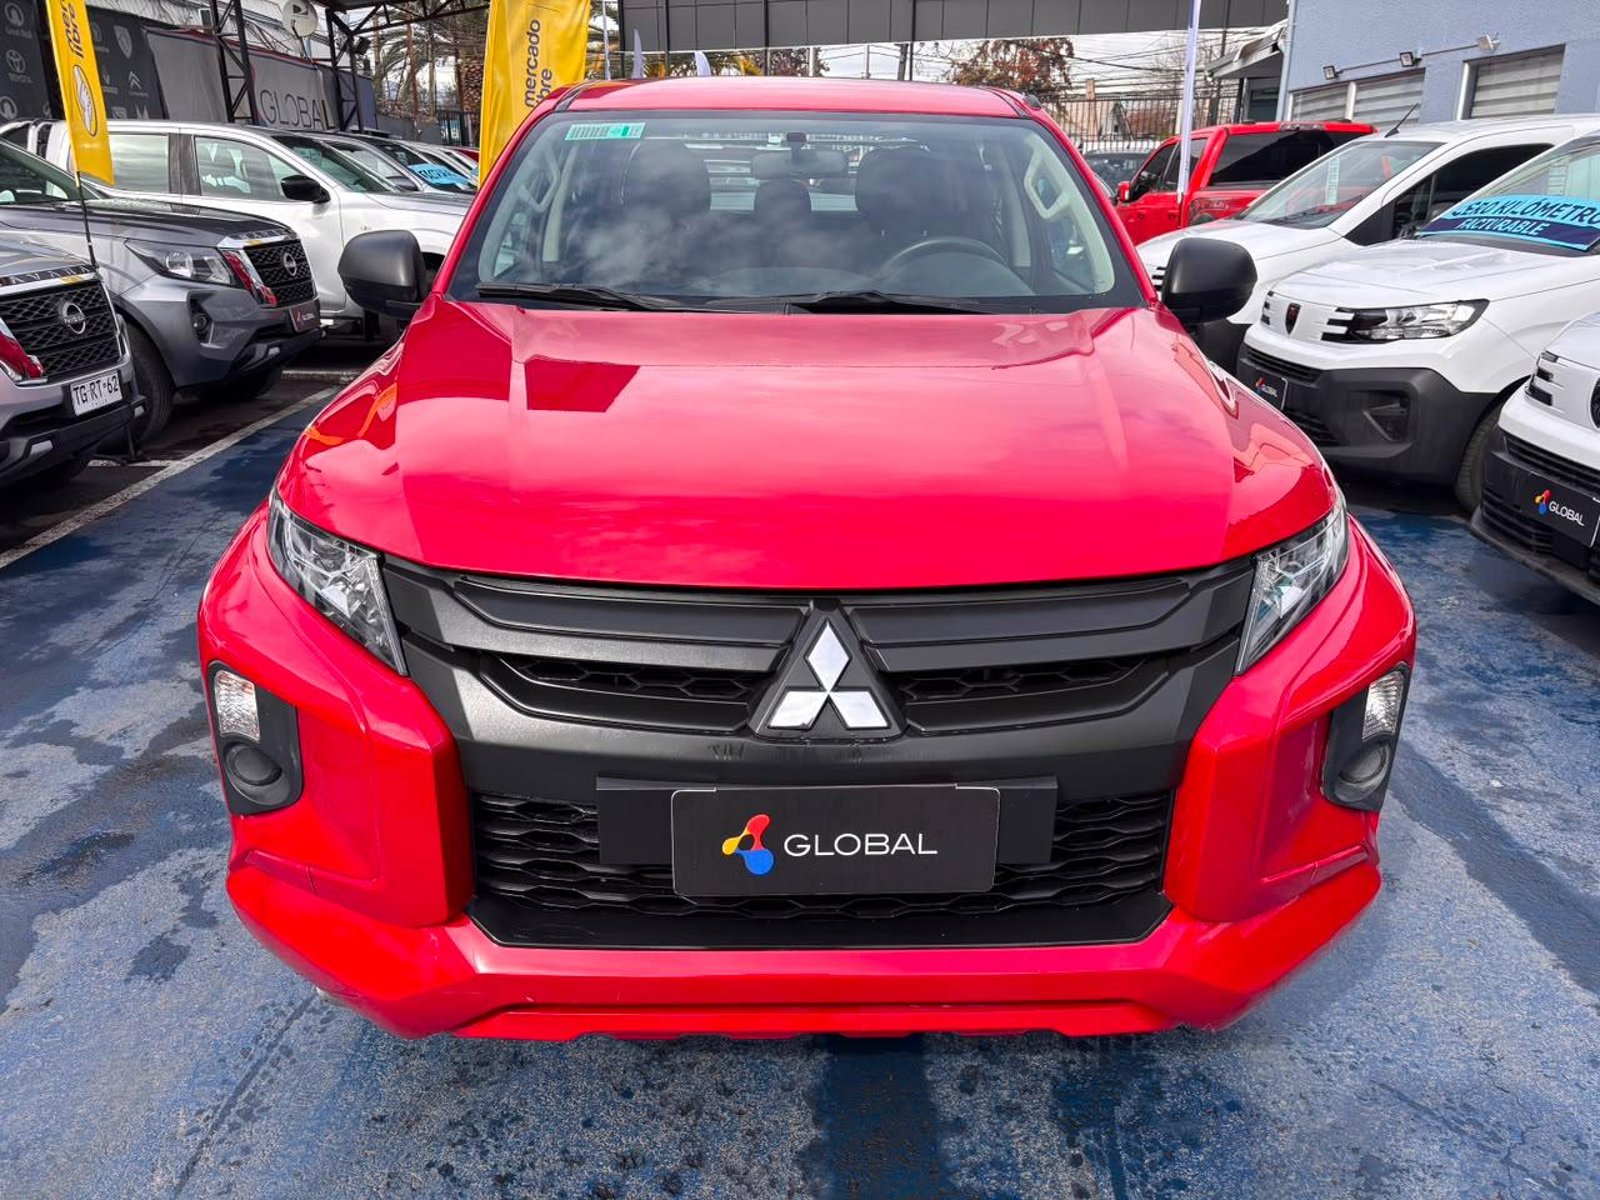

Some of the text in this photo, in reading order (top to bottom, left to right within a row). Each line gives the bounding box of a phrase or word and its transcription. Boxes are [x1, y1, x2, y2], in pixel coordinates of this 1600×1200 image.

[67, 3, 84, 59] libre
[524, 19, 541, 108] mercado
[536, 68, 553, 103] bre
[259, 88, 336, 131] GLOBAL
[1453, 218, 1550, 236] FACTURABLE
[1548, 500, 1585, 527] GLOBAL
[784, 833, 938, 857] GLOBAL
